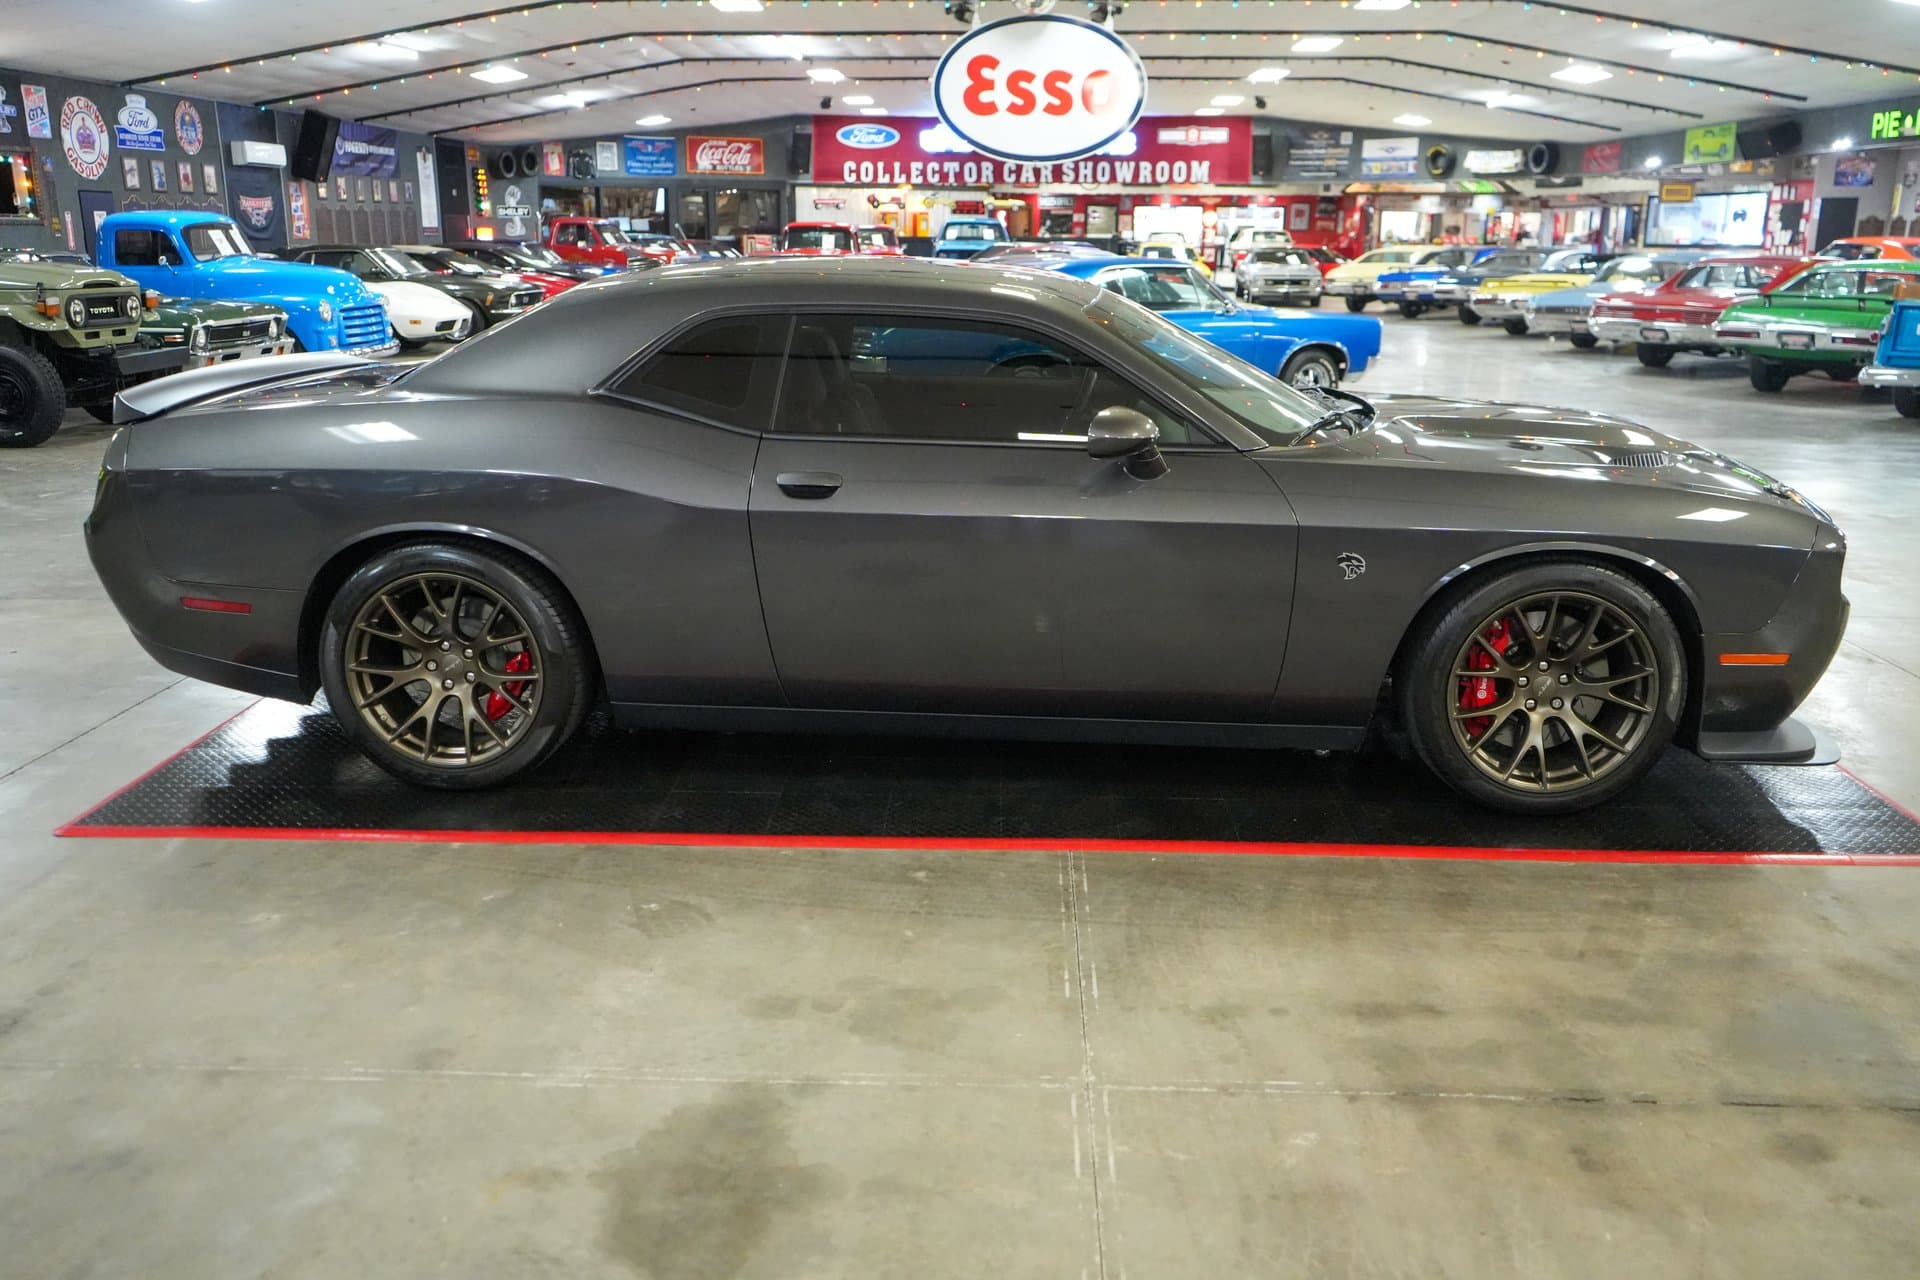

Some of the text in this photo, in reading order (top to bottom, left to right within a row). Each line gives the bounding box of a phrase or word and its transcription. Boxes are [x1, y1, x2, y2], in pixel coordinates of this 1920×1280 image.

[963, 54, 1116, 116] Esso
[28, 105, 46, 121] GTX
[62, 97, 106, 134] RED CROWN
[128, 111, 150, 128] Ford
[1871, 110, 1902, 139] PIE
[850, 127, 887, 143] Ford
[66, 147, 108, 177] GASOLINE
[843, 160, 1211, 185] COLLECTOR CAR SHOWROOM
[90, 306, 115, 314] TOYOTA
